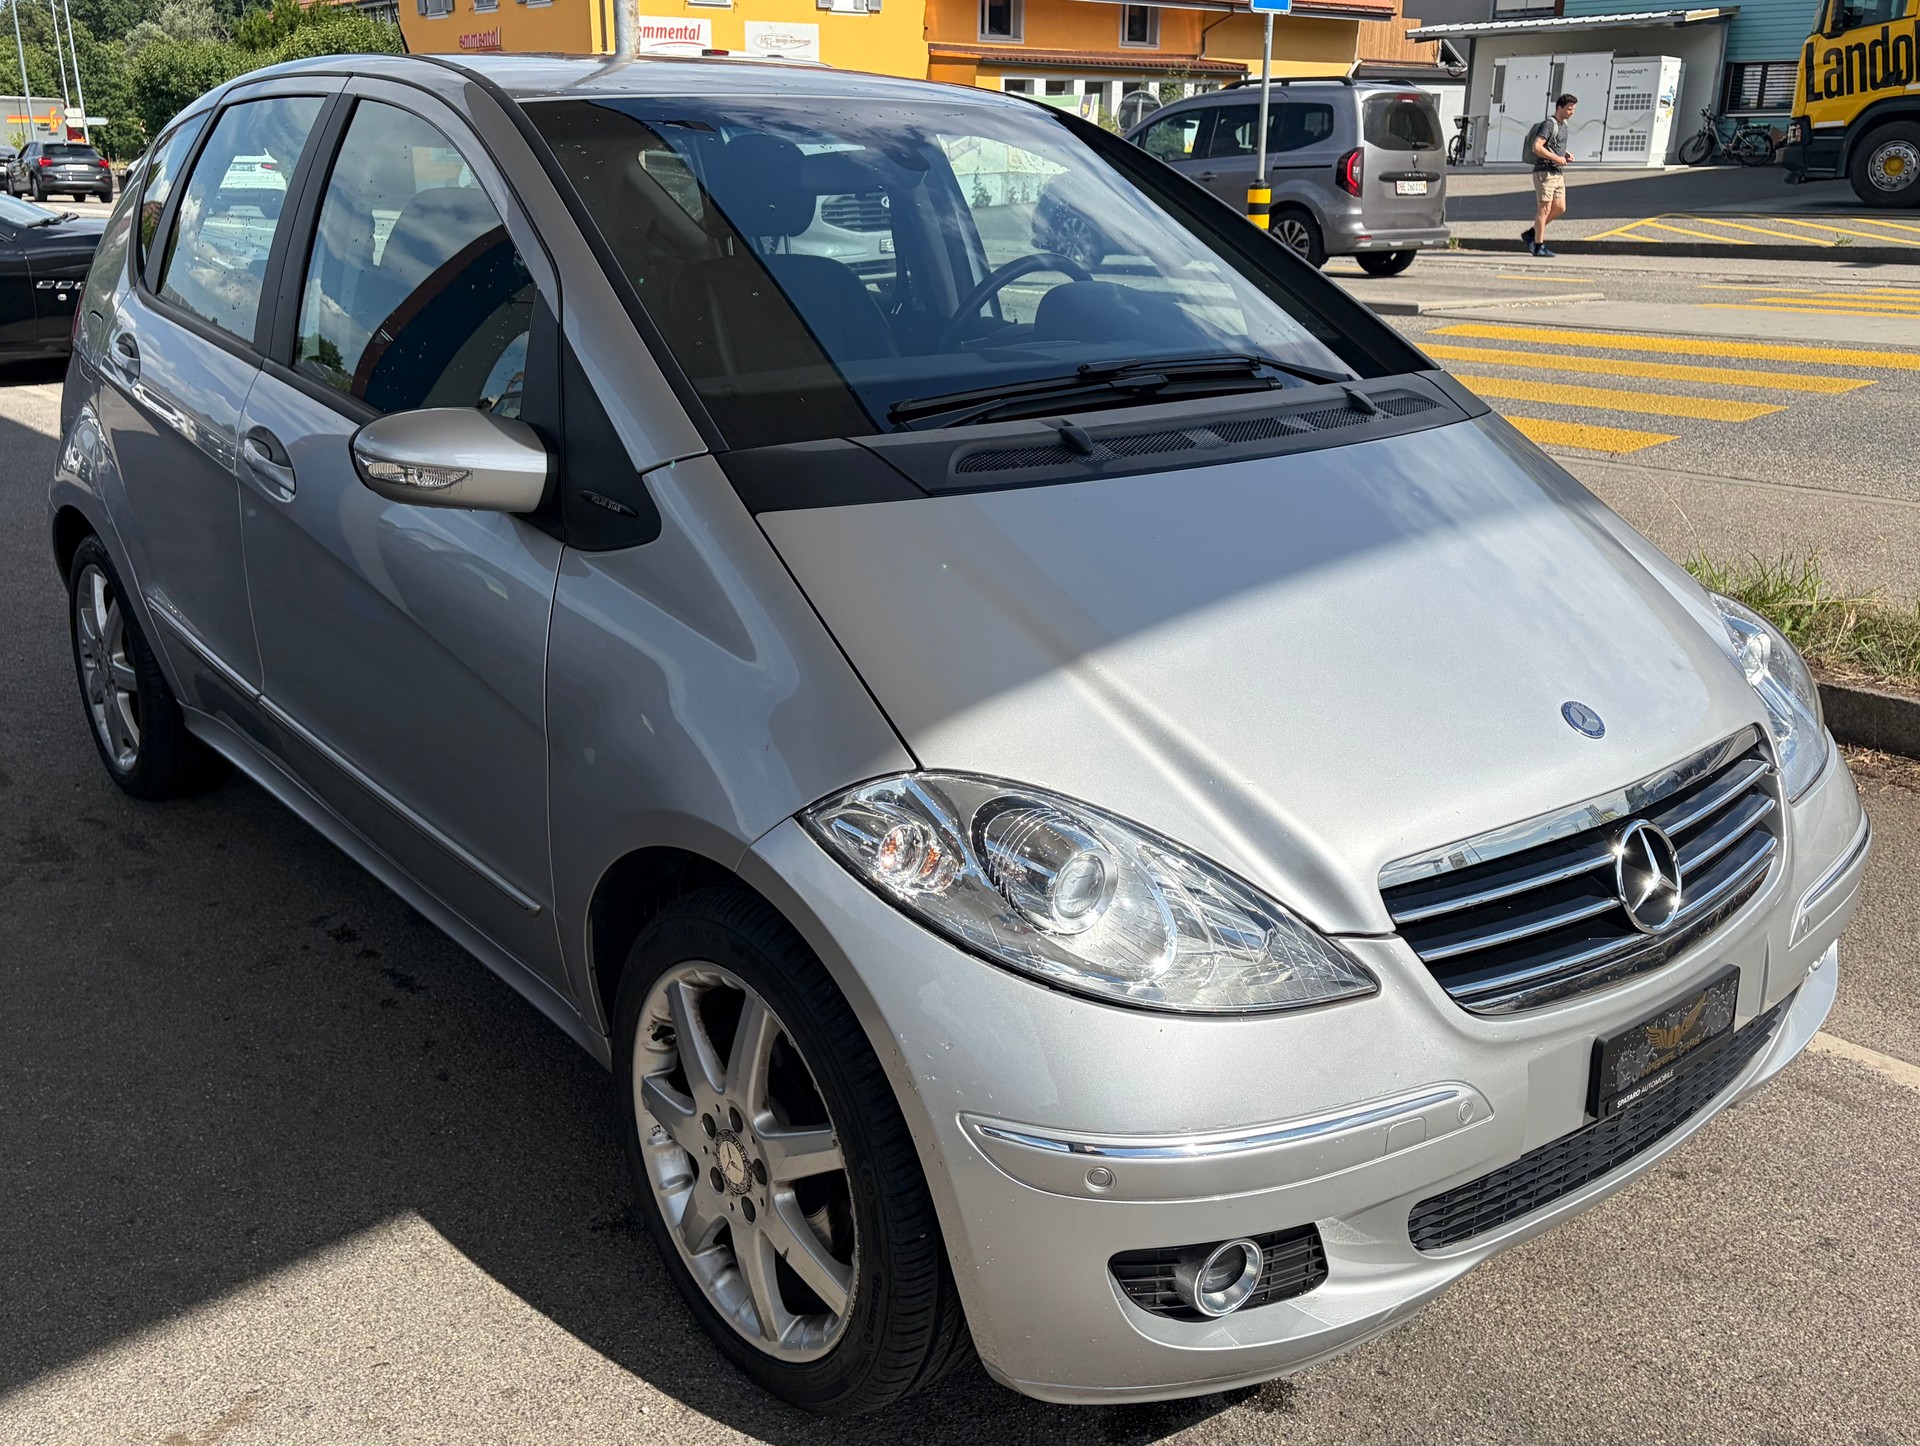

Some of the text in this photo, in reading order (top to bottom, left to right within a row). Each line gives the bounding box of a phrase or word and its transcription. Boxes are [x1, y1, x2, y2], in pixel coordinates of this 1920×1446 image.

[608, 501, 621, 512] STAR
[1617, 1069, 1675, 1108] SPATARO AUTOMOBILE
